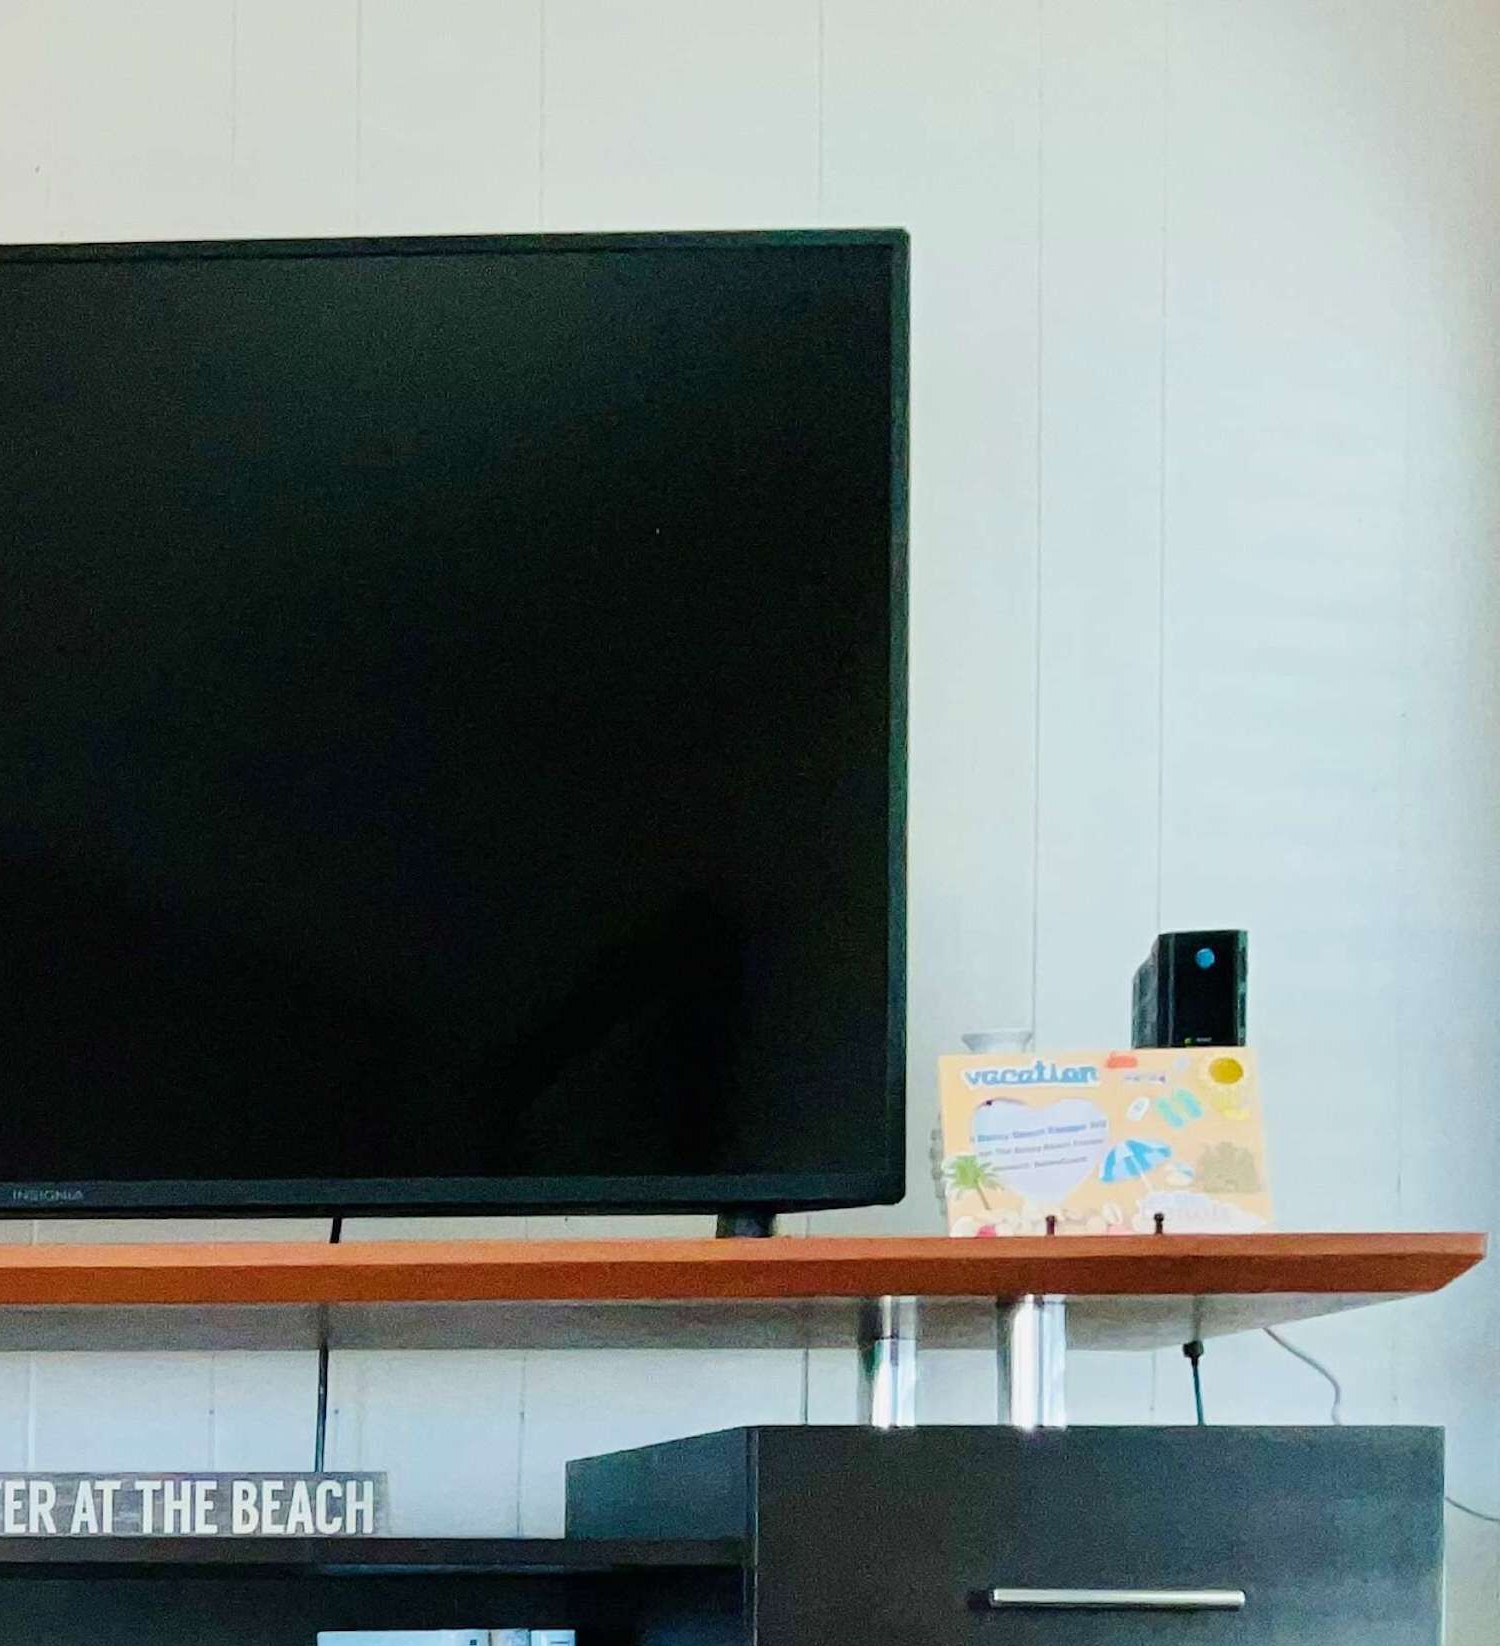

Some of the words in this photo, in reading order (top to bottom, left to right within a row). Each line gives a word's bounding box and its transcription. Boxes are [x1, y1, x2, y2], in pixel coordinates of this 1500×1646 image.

[965, 1060, 1098, 1086] vacation
[12, 1189, 84, 1201] INSIGNIA
[70, 1480, 121, 1535] AT
[134, 1480, 218, 1535] THE
[231, 1480, 374, 1535] BEACH
